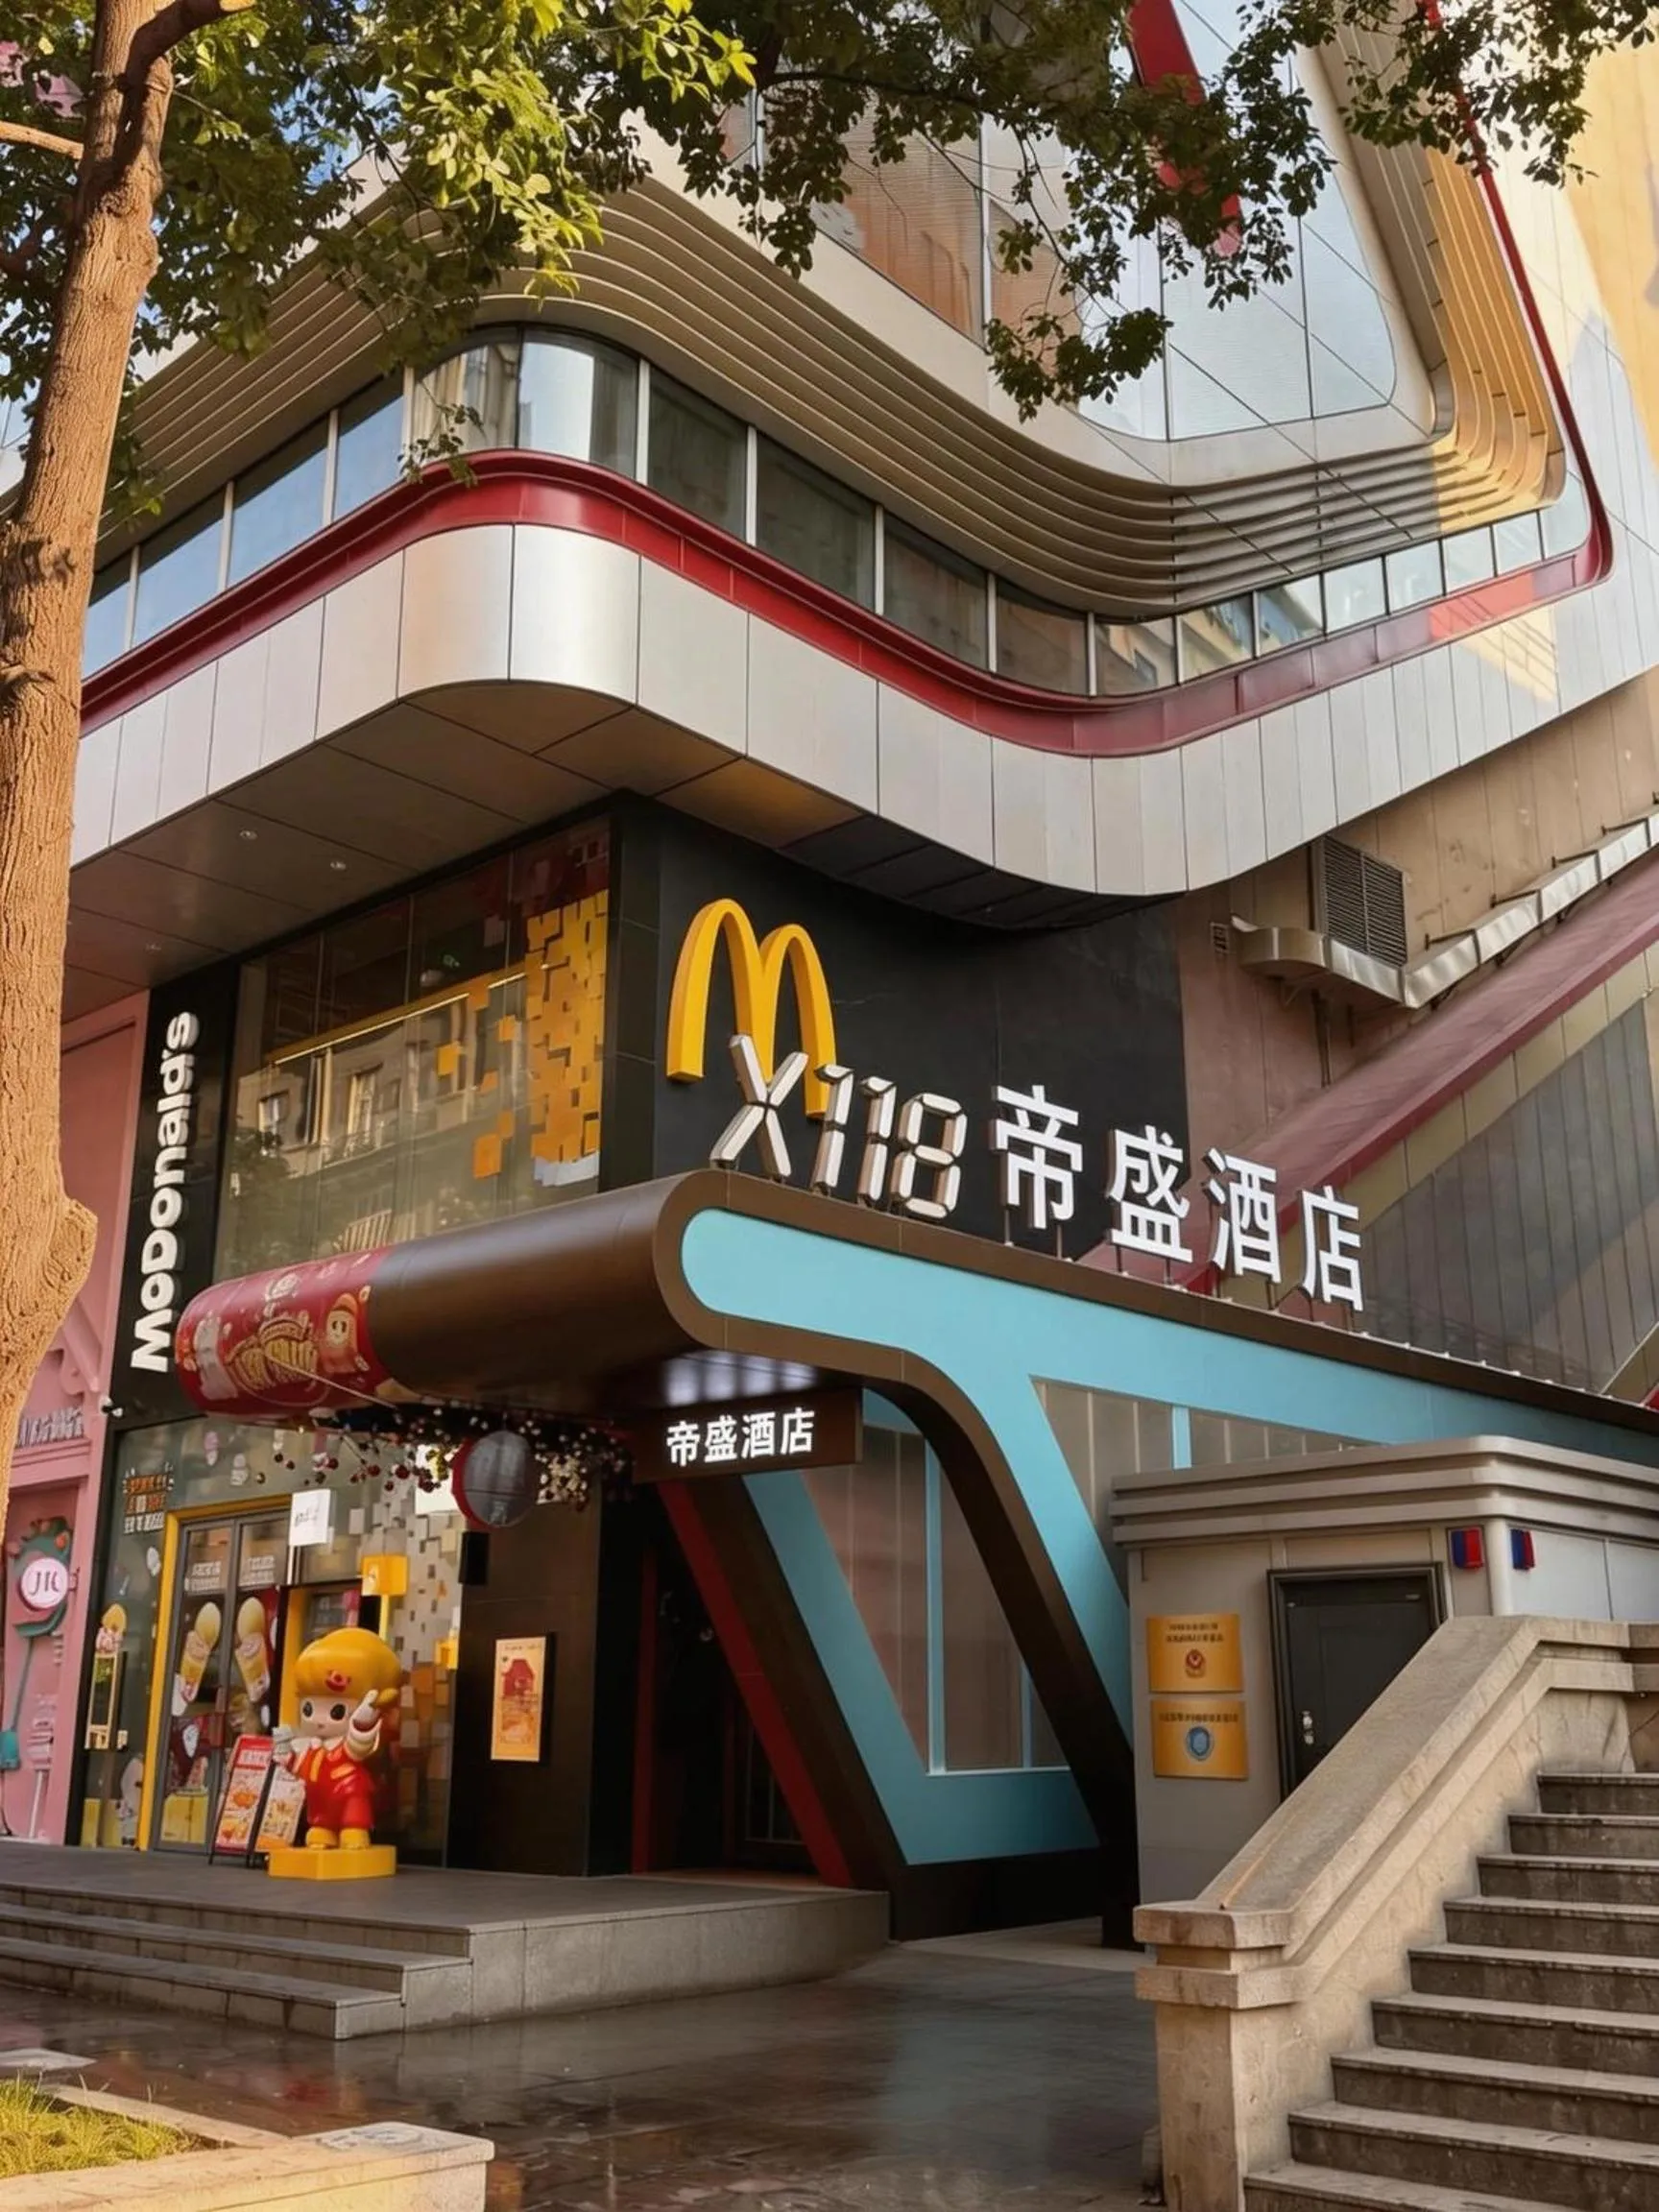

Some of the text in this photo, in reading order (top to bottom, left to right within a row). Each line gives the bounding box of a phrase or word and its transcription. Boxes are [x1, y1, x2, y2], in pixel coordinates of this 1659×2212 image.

[709, 1034, 1364, 1312] X118 帝盛酒店
[665, 1407, 815, 1467] 帝盛酒店
